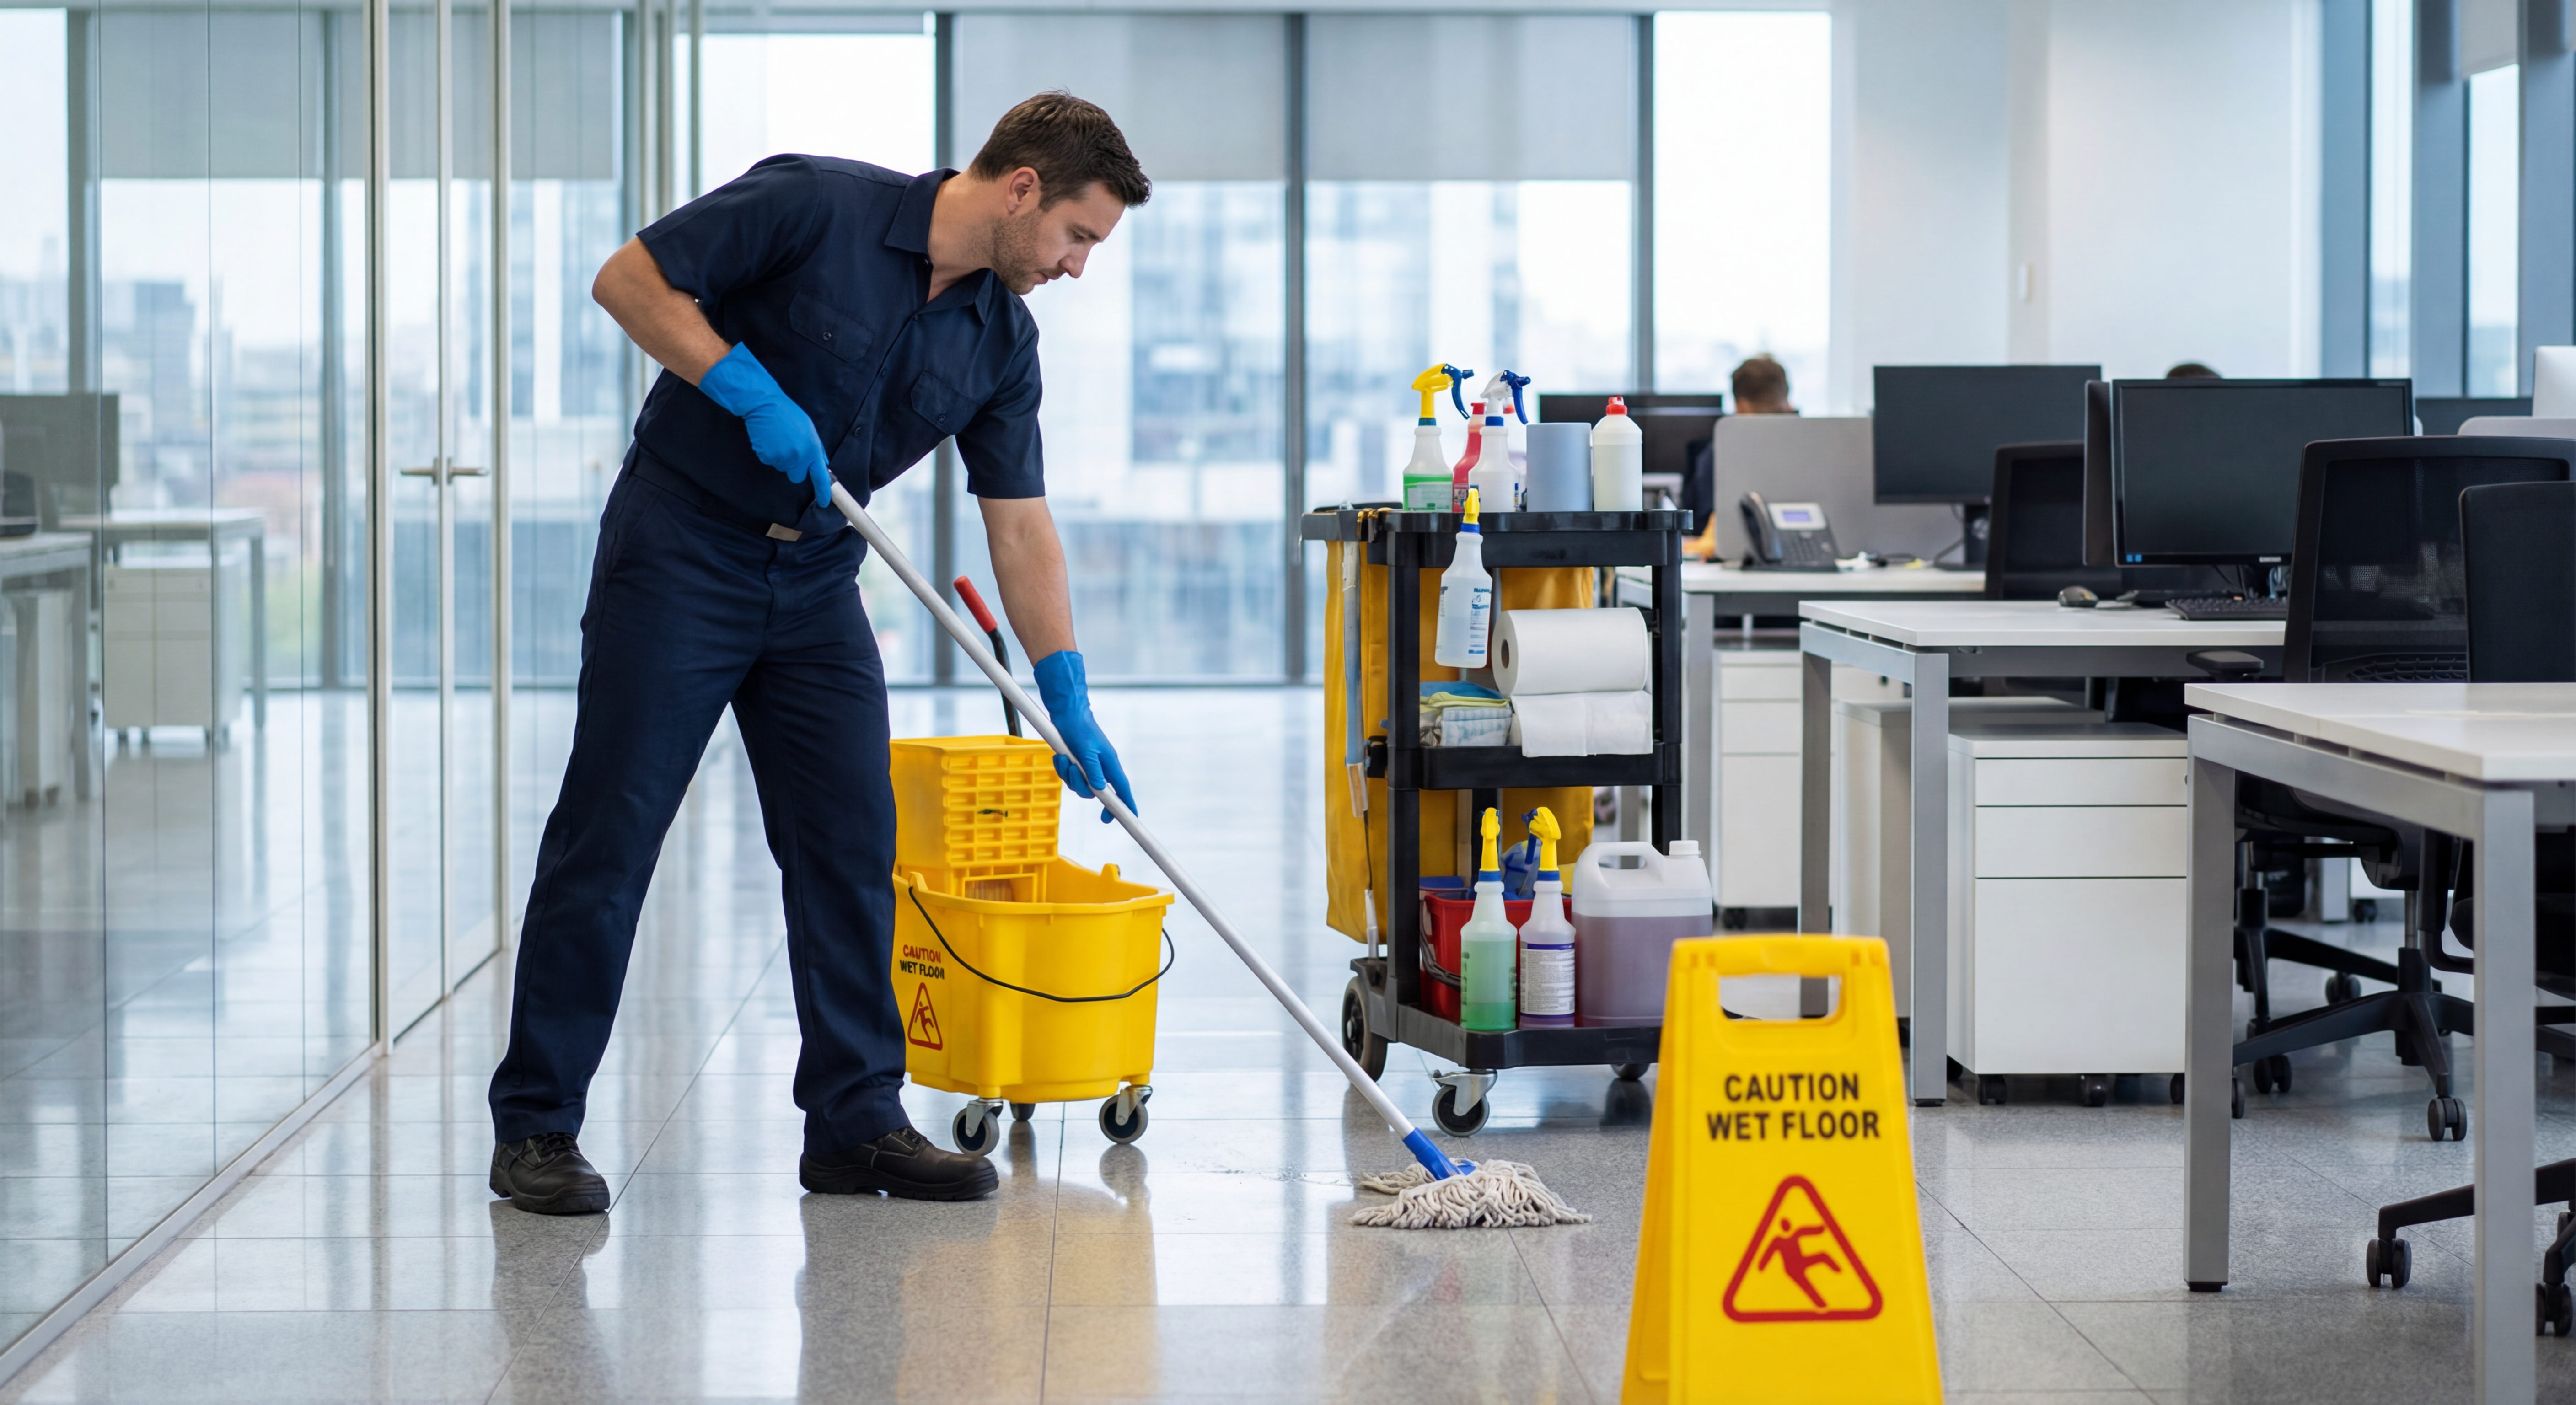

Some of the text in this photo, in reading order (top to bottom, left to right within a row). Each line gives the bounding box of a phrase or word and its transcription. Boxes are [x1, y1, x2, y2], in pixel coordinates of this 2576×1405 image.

[903, 944, 941, 964] CAUTION
[899, 959, 918, 975] WET
[1724, 1073, 1860, 1103] CAUTION
[1706, 1110, 1880, 1141] WET FLOOR
